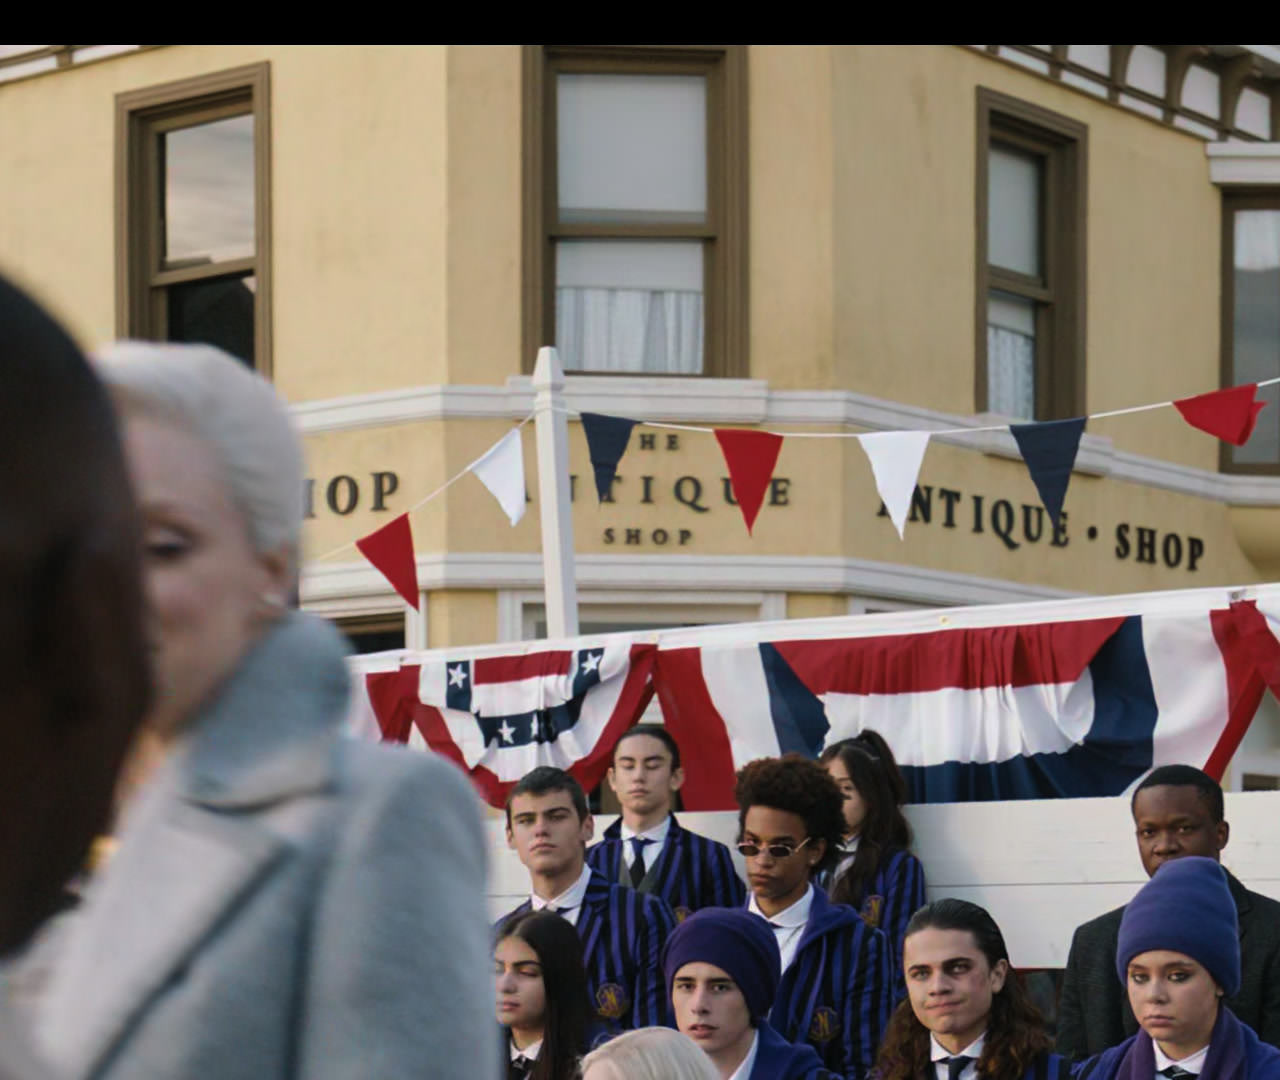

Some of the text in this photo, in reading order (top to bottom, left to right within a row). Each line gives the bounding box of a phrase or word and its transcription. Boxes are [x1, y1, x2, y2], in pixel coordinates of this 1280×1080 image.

[639, 433, 679, 451] HE
[525, 474, 791, 513] TIQE
[603, 528, 692, 546] SHOP
[876, 483, 1205, 572] NTIQUE SHOP
